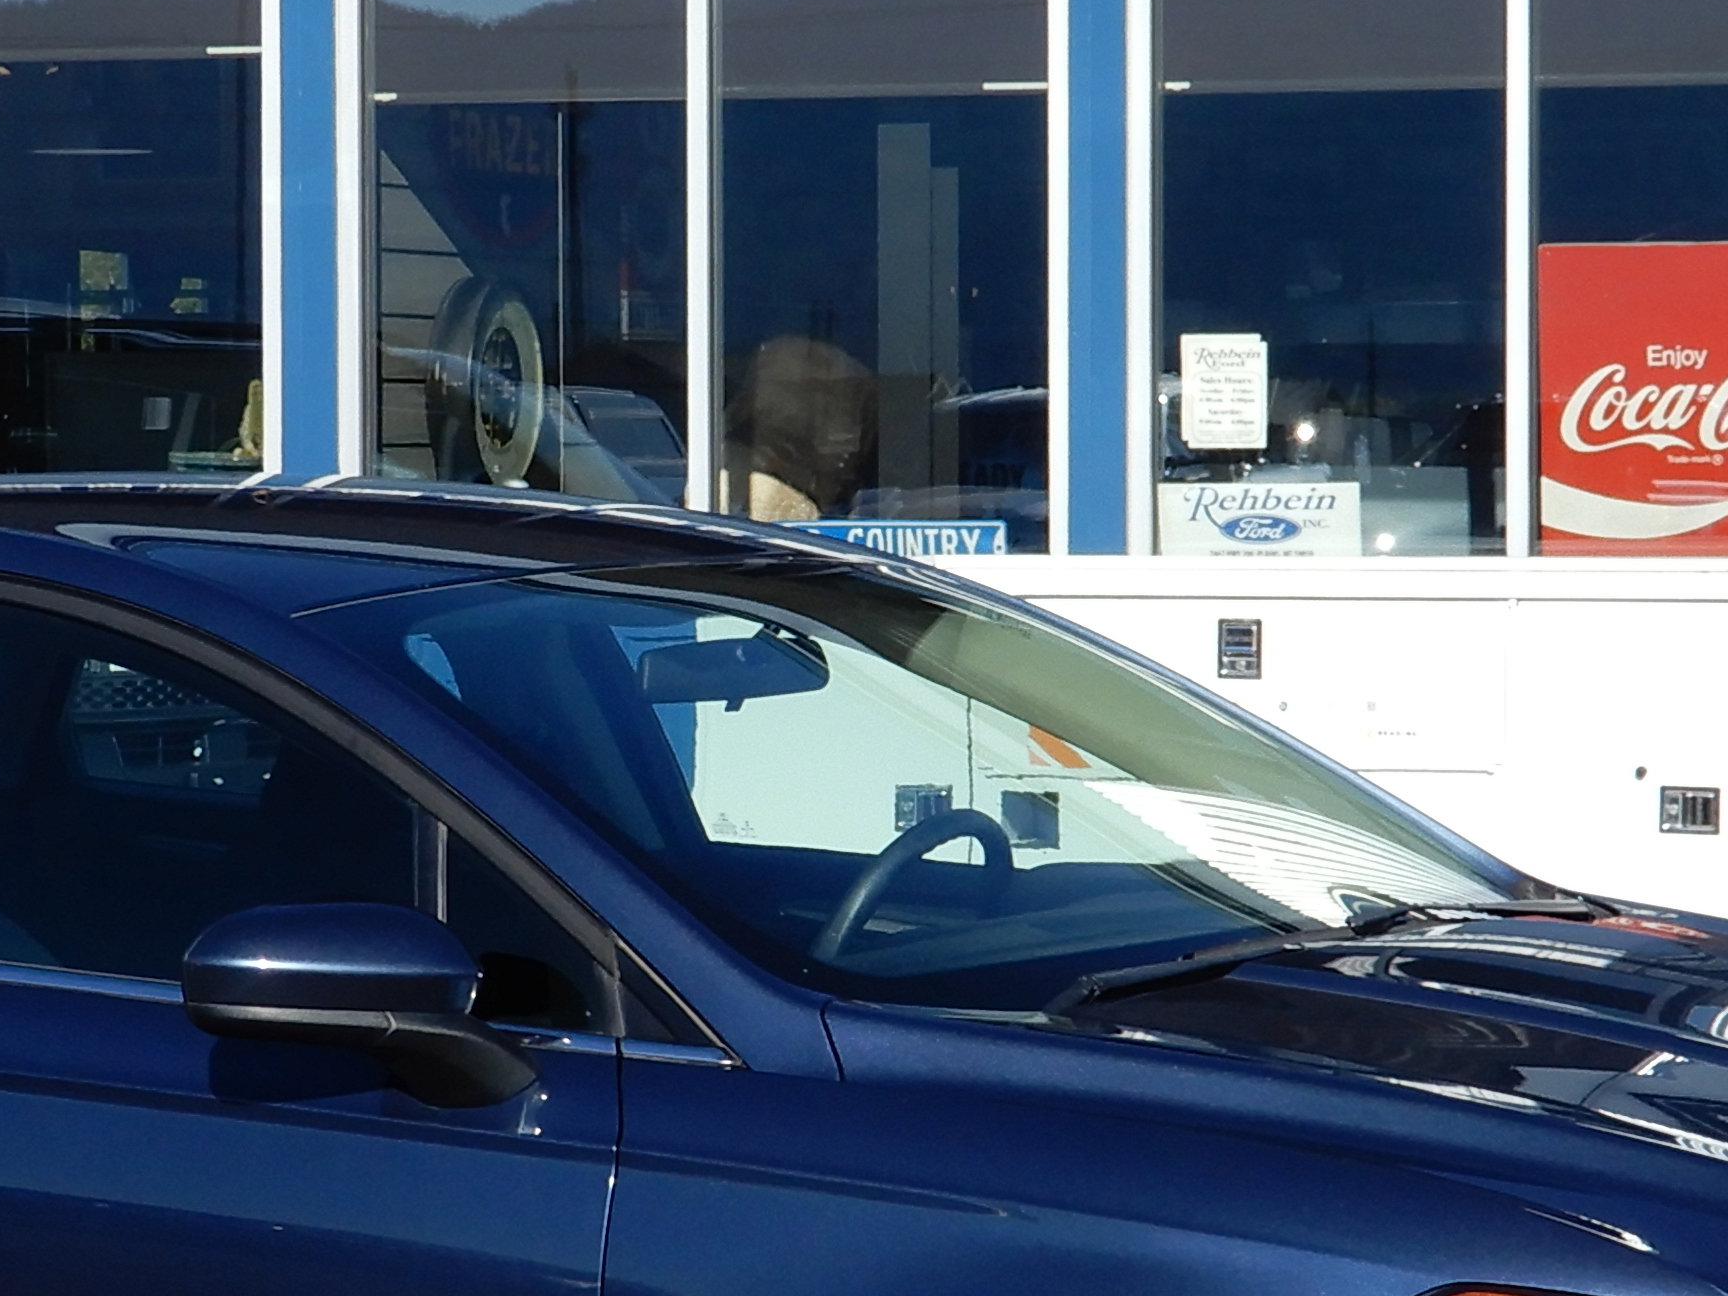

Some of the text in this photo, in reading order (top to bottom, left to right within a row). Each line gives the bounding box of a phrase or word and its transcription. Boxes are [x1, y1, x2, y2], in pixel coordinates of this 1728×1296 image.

[1646, 344, 1708, 370] Enjoy
[1183, 486, 1336, 530] Rehbein
[847, 527, 982, 556] COUNTRY
[1234, 517, 1330, 539] Ford INC.
